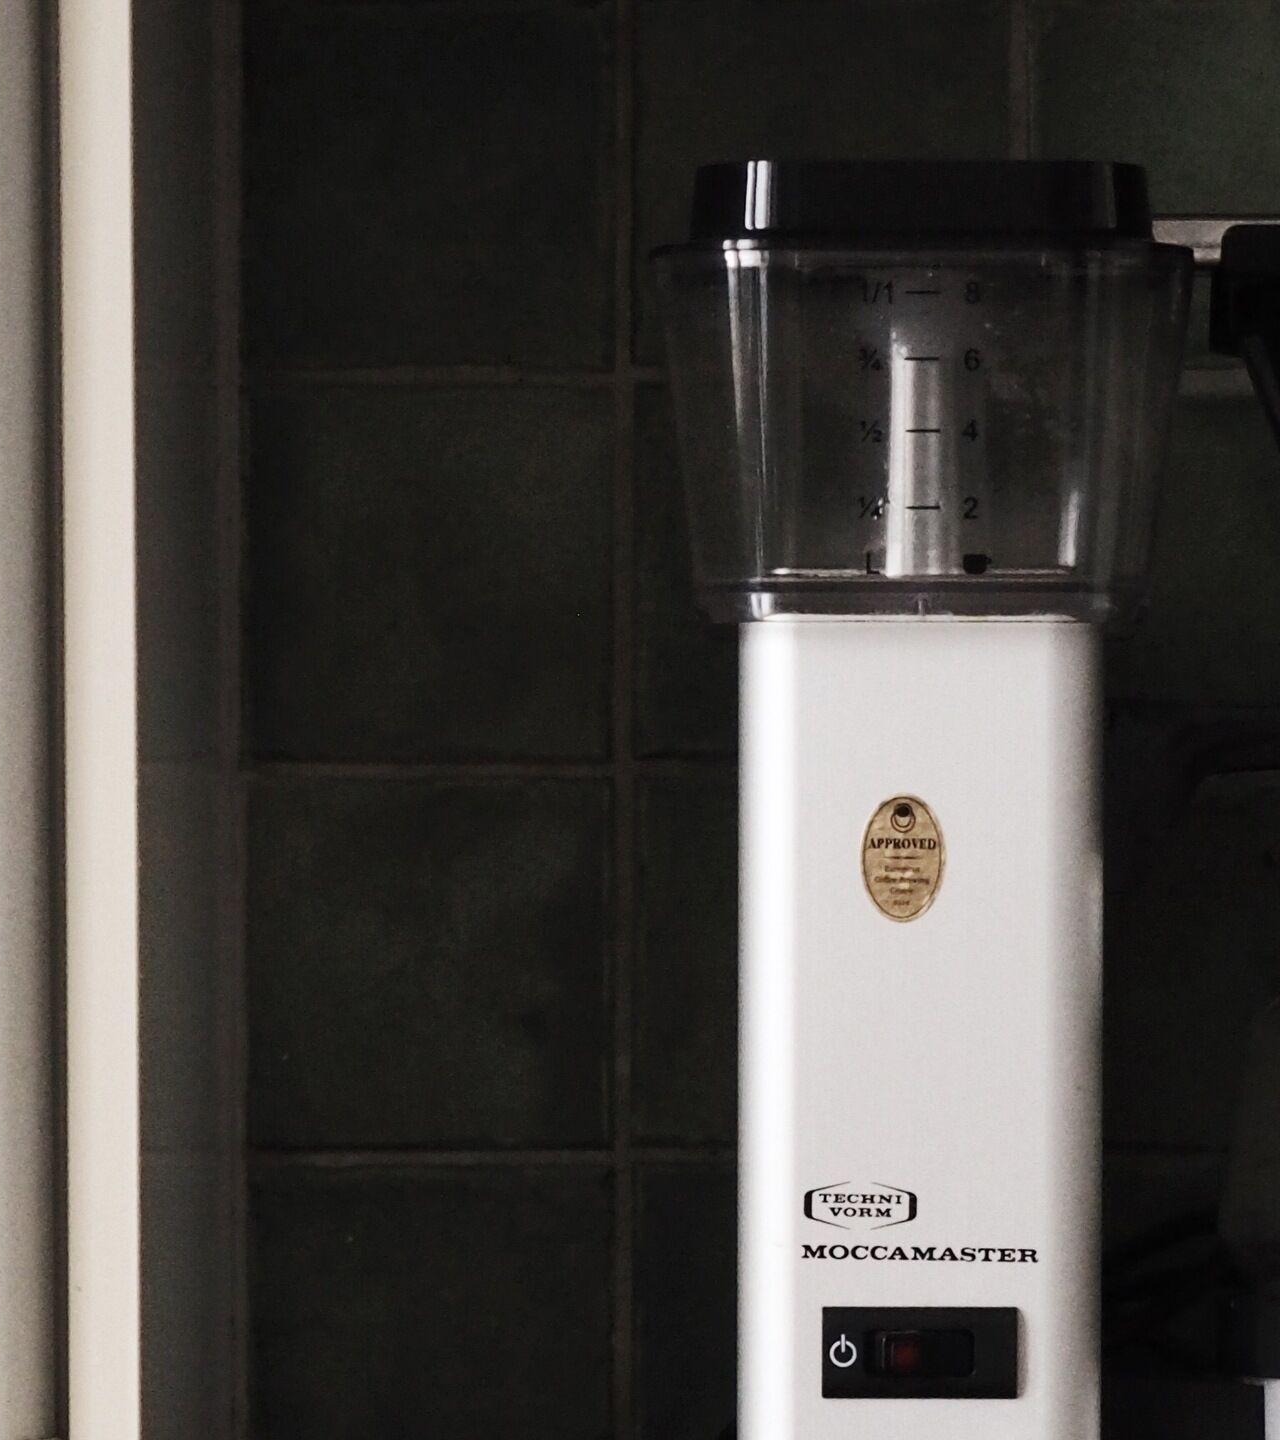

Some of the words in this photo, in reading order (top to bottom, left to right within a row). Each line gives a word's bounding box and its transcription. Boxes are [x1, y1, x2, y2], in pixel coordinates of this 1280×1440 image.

[963, 349, 981, 371] 6
[962, 419, 979, 441] 4
[963, 497, 979, 519] 2
[870, 837, 937, 850] APPROVED
[818, 1193, 903, 1205] TECHNI
[829, 1206, 893, 1218] VORM
[801, 1244, 1039, 1264] MOCCAMASTER
